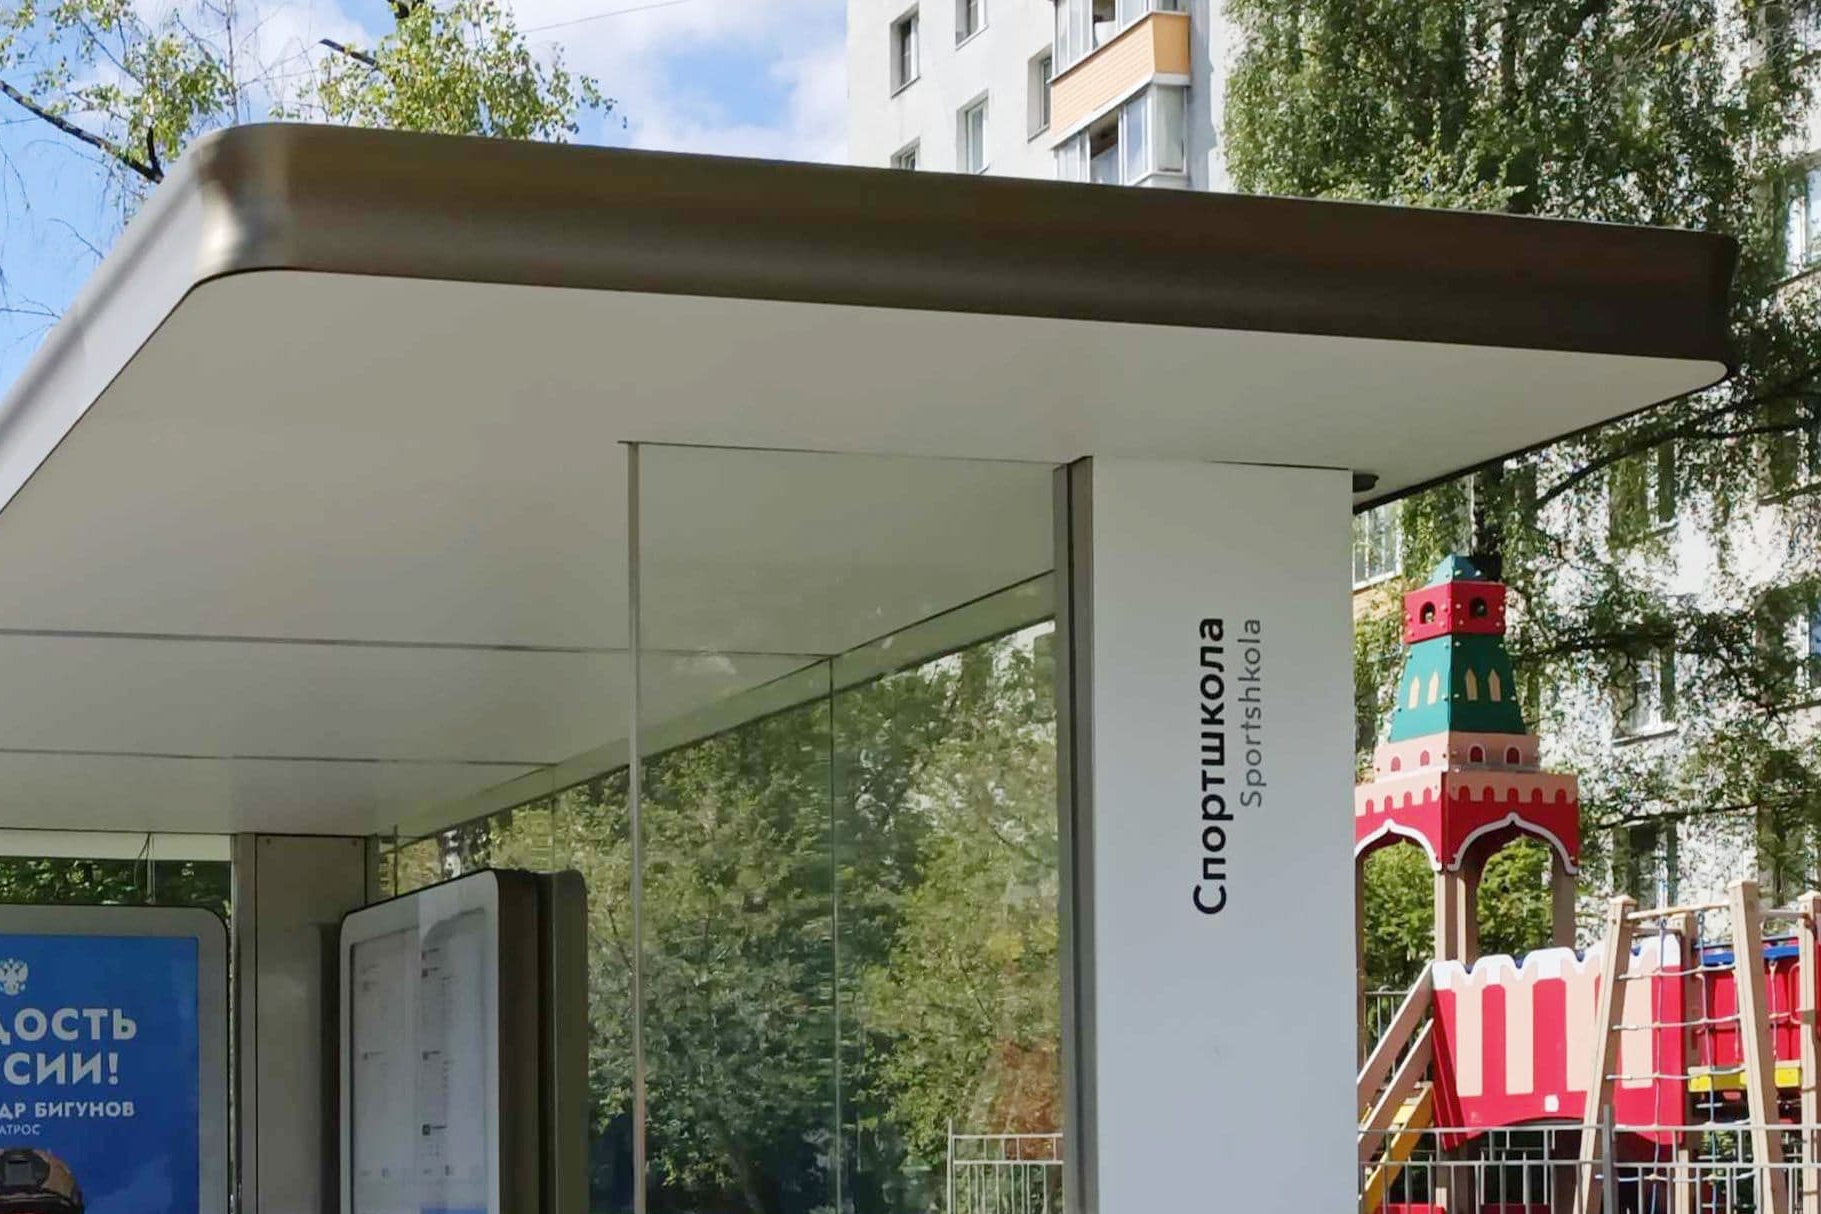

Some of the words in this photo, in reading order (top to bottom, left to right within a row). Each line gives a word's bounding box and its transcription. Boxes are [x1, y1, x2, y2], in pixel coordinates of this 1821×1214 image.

[1193, 617, 1234, 915] Спортшкола
[1237, 618, 1267, 808] Sportshkola
[34, 1101, 135, 1119] БИГУНОВ
